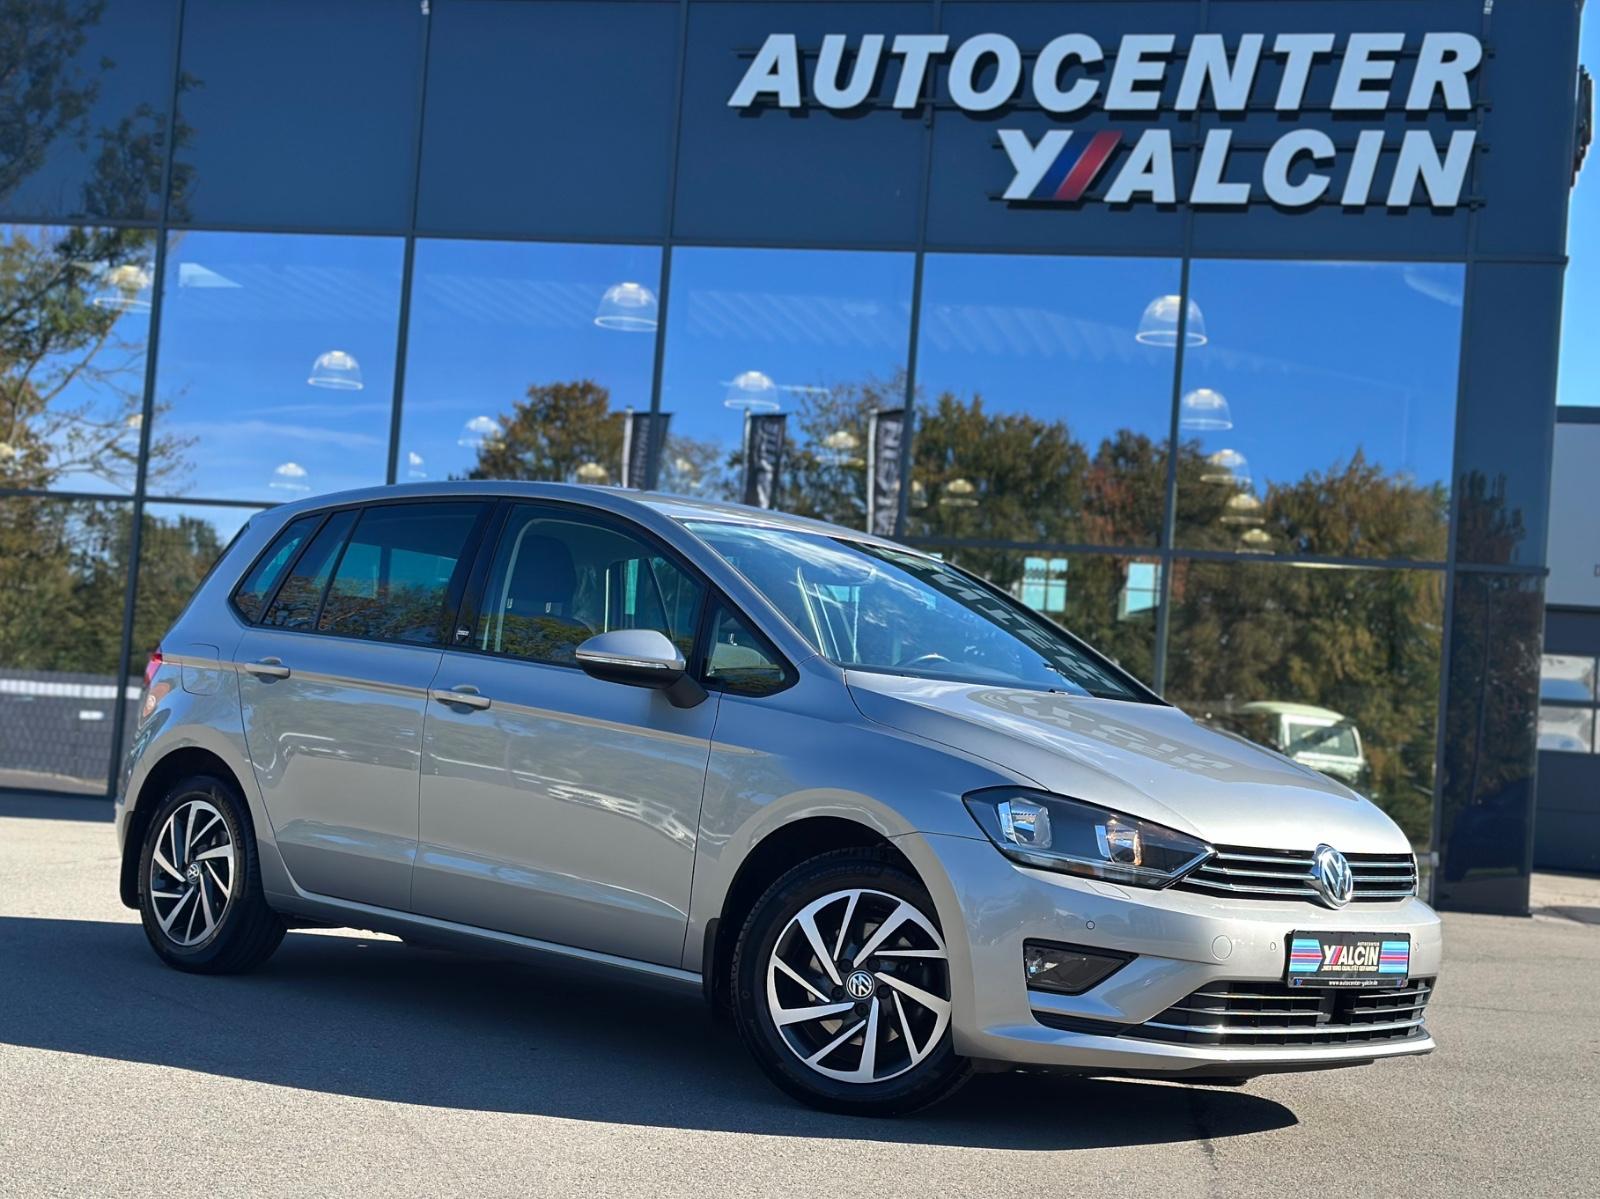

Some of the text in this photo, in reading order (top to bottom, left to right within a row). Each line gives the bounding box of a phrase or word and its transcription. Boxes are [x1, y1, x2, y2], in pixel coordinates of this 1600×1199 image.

[728, 32, 1482, 112] AUTOCENTER
[997, 128, 1476, 208] YALCIN
[1323, 945, 1380, 965] YALCIN
